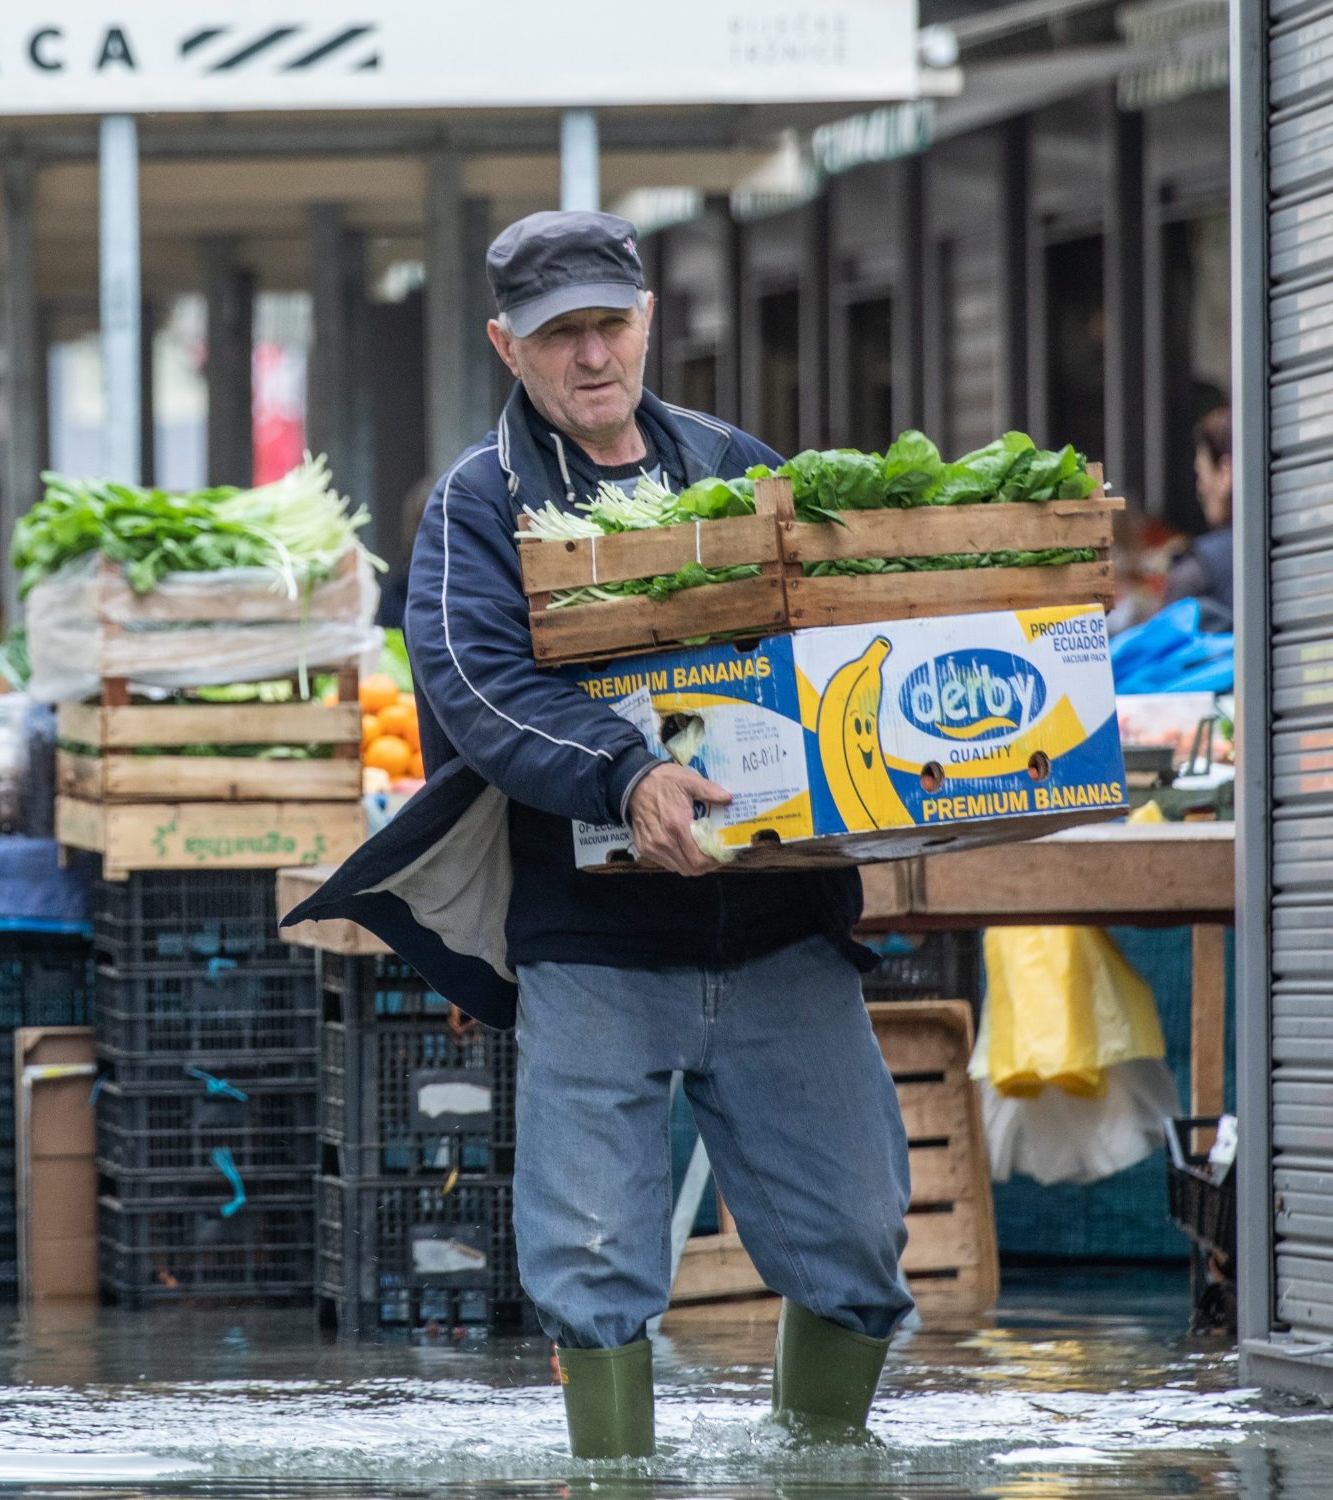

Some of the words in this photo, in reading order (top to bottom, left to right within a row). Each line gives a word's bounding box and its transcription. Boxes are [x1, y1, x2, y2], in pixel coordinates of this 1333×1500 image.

[1030, 620, 1087, 637] PRODUCE
[1090, 619, 1104, 633] OF
[1053, 635, 1106, 652] ECUADOR
[1062, 654, 1089, 664] VACUUM
[1091, 653, 1107, 662] PACK
[673, 656, 771, 688] BANANAS
[910, 657, 1035, 731] derby
[949, 745, 1012, 763] QUALITY
[922, 790, 1028, 821] PREMIUM
[1034, 782, 1122, 809] BANANAS
[578, 823, 591, 833] OF
[579, 835, 608, 846] VACUUM
[610, 832, 630, 842] PACK
